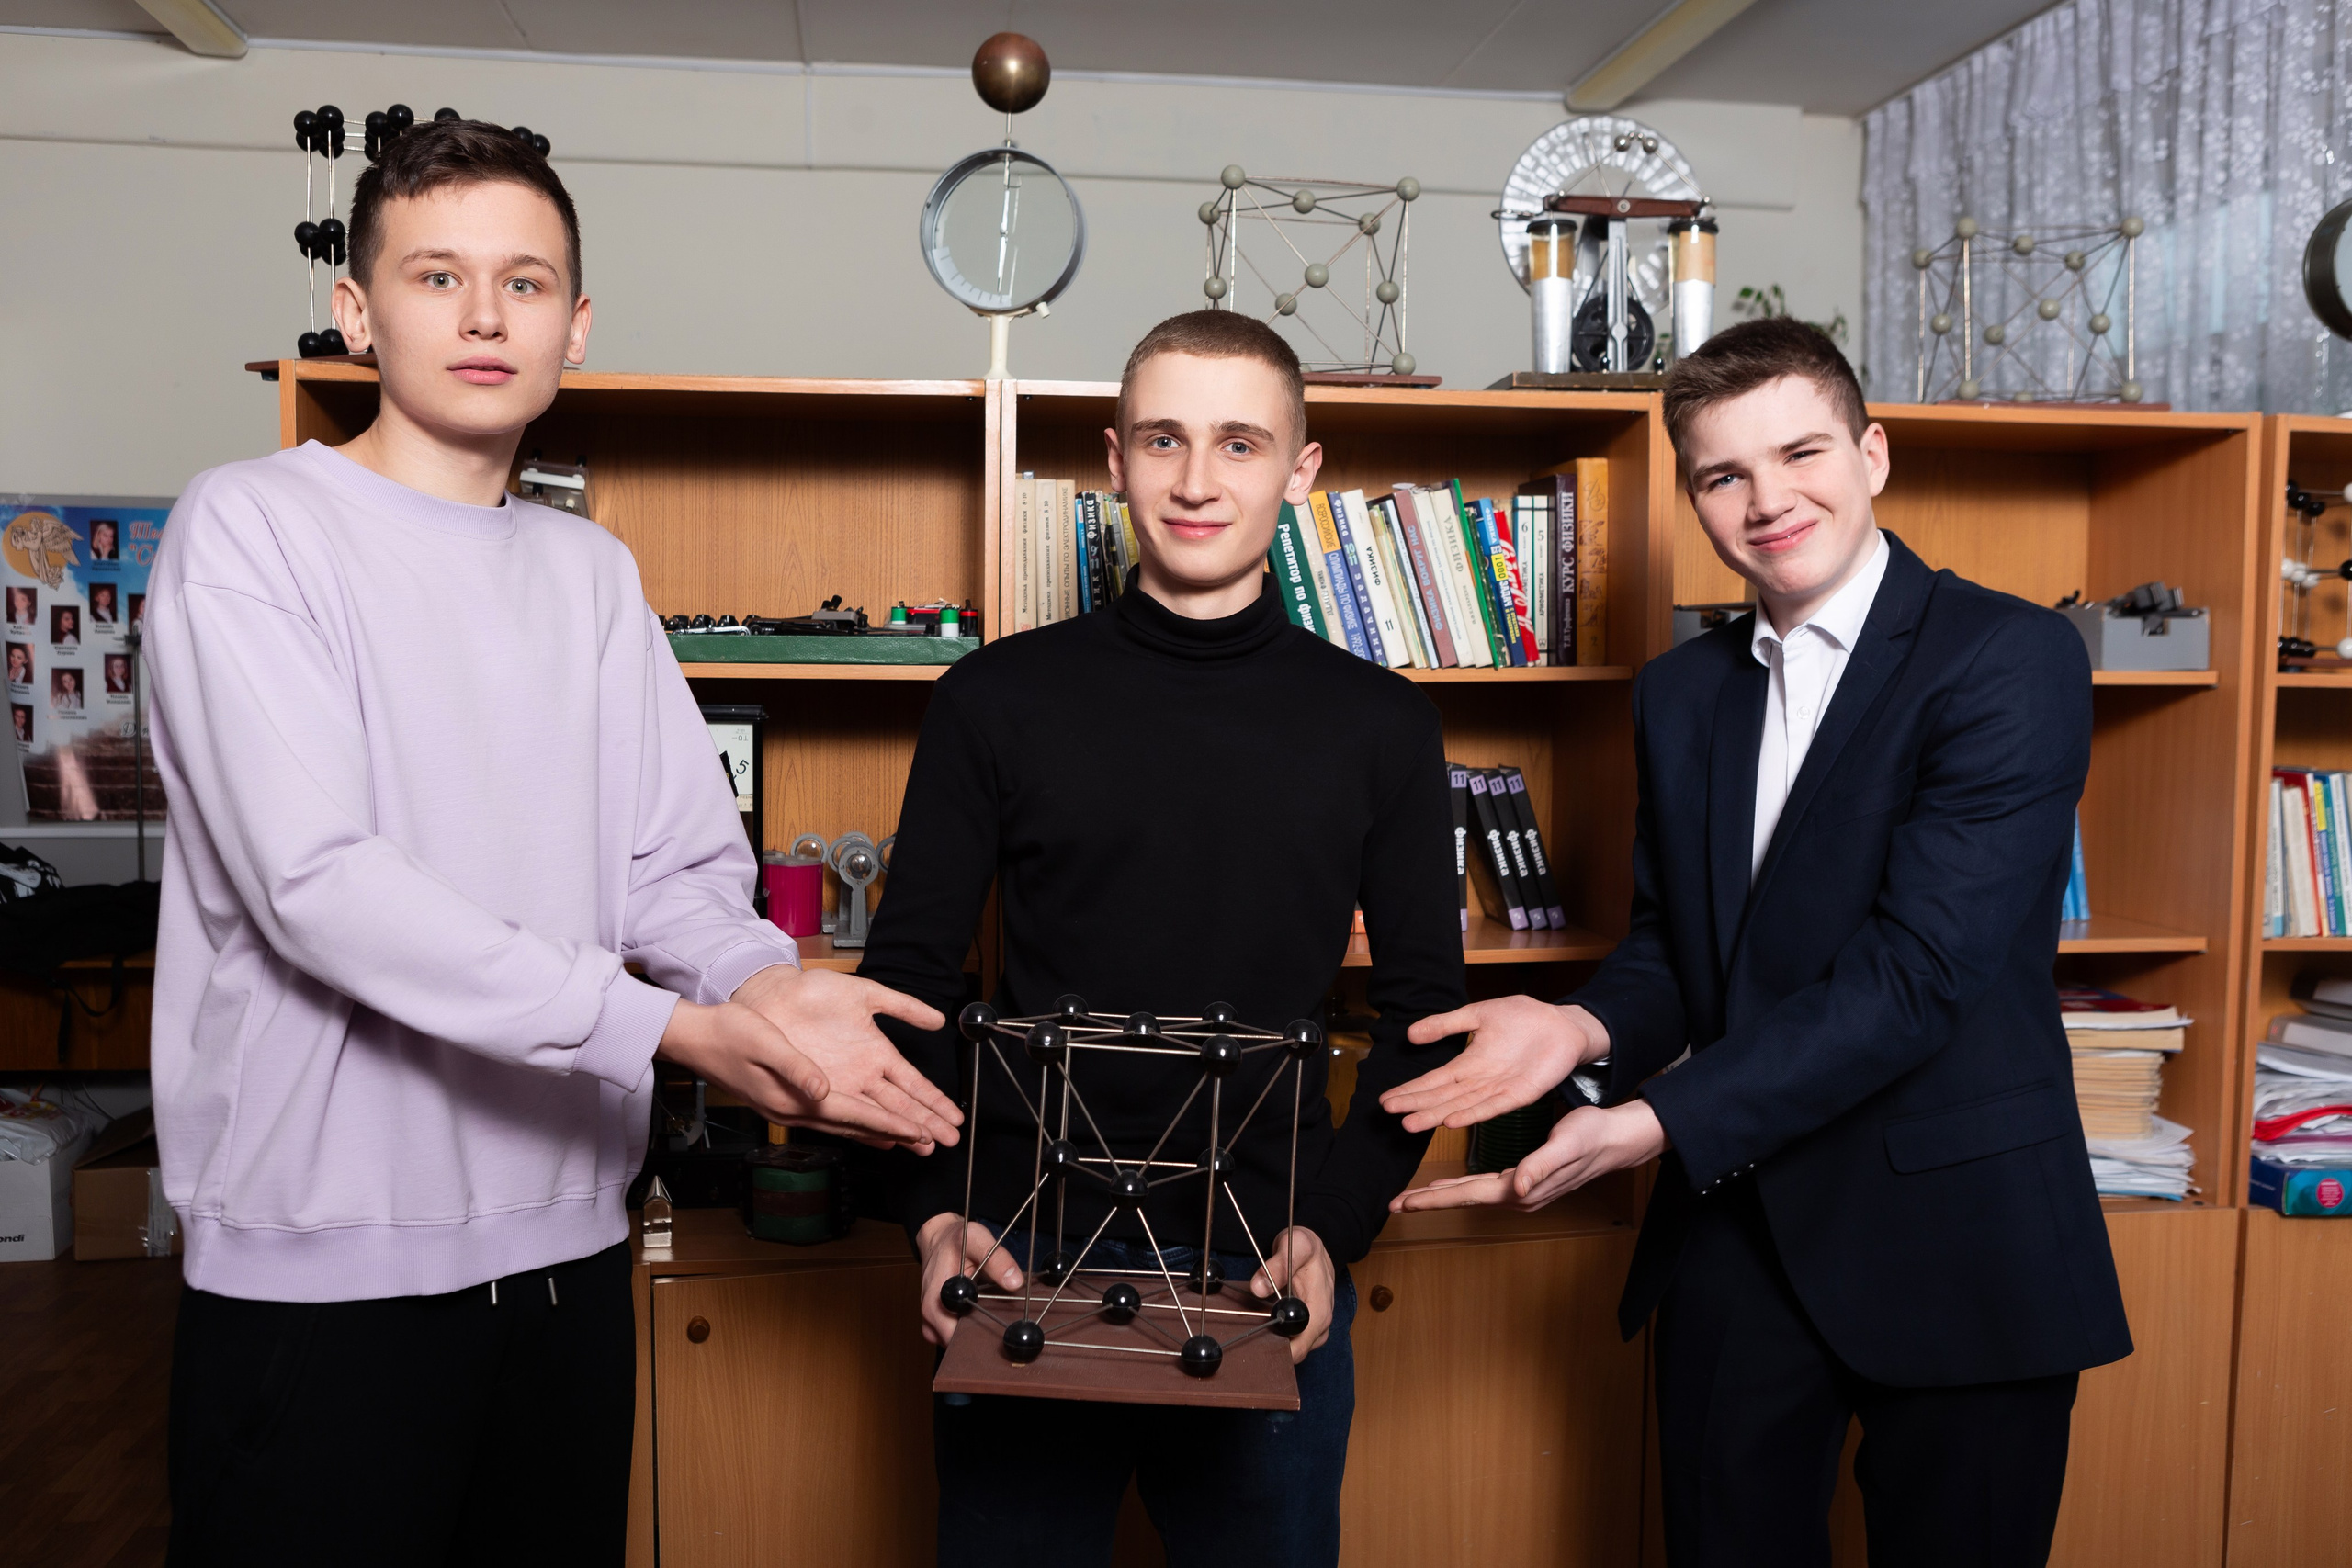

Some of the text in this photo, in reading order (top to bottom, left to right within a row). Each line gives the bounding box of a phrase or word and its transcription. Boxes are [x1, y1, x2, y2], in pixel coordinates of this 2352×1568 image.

[1086, 500, 1097, 539] Физика
[1316, 502, 1336, 549] ВСЕРОССИЙСКИЕ
[1334, 500, 1349, 536] Физика
[1485, 507, 1498, 544] ФИЗИКА
[1521, 522, 1528, 533] 6
[1562, 492, 1574, 552] ФИЗИКИ
[1443, 514, 1463, 573] ФИЗИКА
[1538, 530, 1544, 541] 5
[1064, 553, 1069, 562] ПО
[1344, 542, 1355, 553] 10
[1091, 558, 1099, 569] 11
[1278, 523, 1302, 584] Репетитор
[1295, 585, 1306, 601] по
[1348, 555, 1358, 566] 11
[1366, 546, 1381, 586] ФИЗИКА
[1495, 557, 1506, 579] 1000
[1329, 551, 1347, 593] ОЛИМПИАДЫ
[1408, 525, 1443, 631] ФИЗИКА ВОКРУГ НАС
[1562, 557, 1575, 593] КУРС
[1340, 592, 1351, 604] ПО
[1499, 581, 1513, 607] ЗАДАЧ
[1343, 604, 1358, 630] ФИЗИКЕ
[1385, 619, 1395, 632] 11
[736, 759, 750, 775] 5
[1453, 773, 1464, 784] 11
[1473, 779, 1485, 792] 11
[1492, 781, 1504, 792] 11
[1510, 779, 1522, 790] 11
